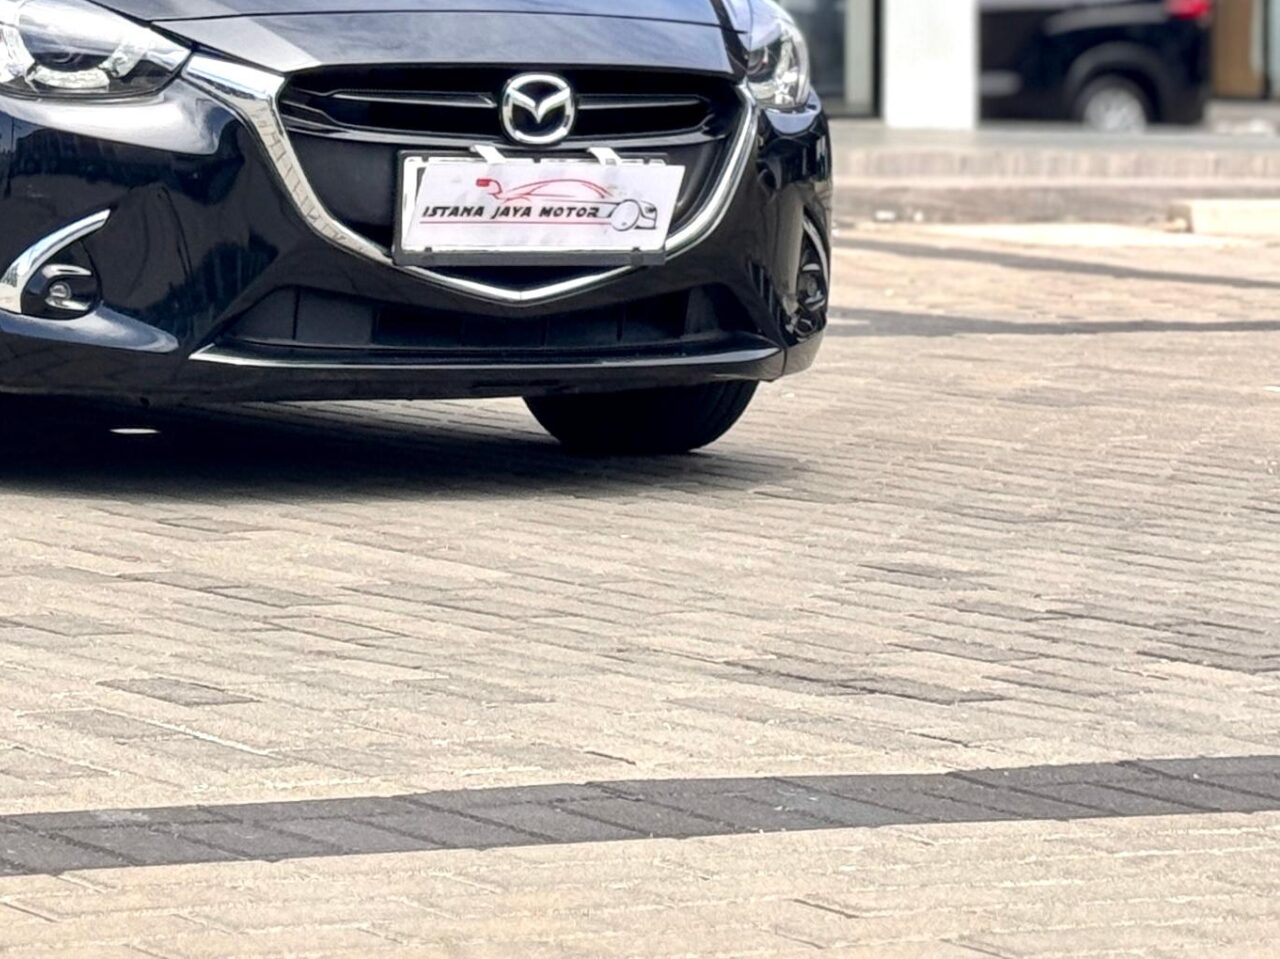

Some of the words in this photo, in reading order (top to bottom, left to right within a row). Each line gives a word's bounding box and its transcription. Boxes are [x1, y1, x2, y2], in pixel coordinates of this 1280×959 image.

[422, 205, 484, 218] ISTANA
[490, 205, 532, 220] JAYA
[538, 205, 601, 219] MOTOR
